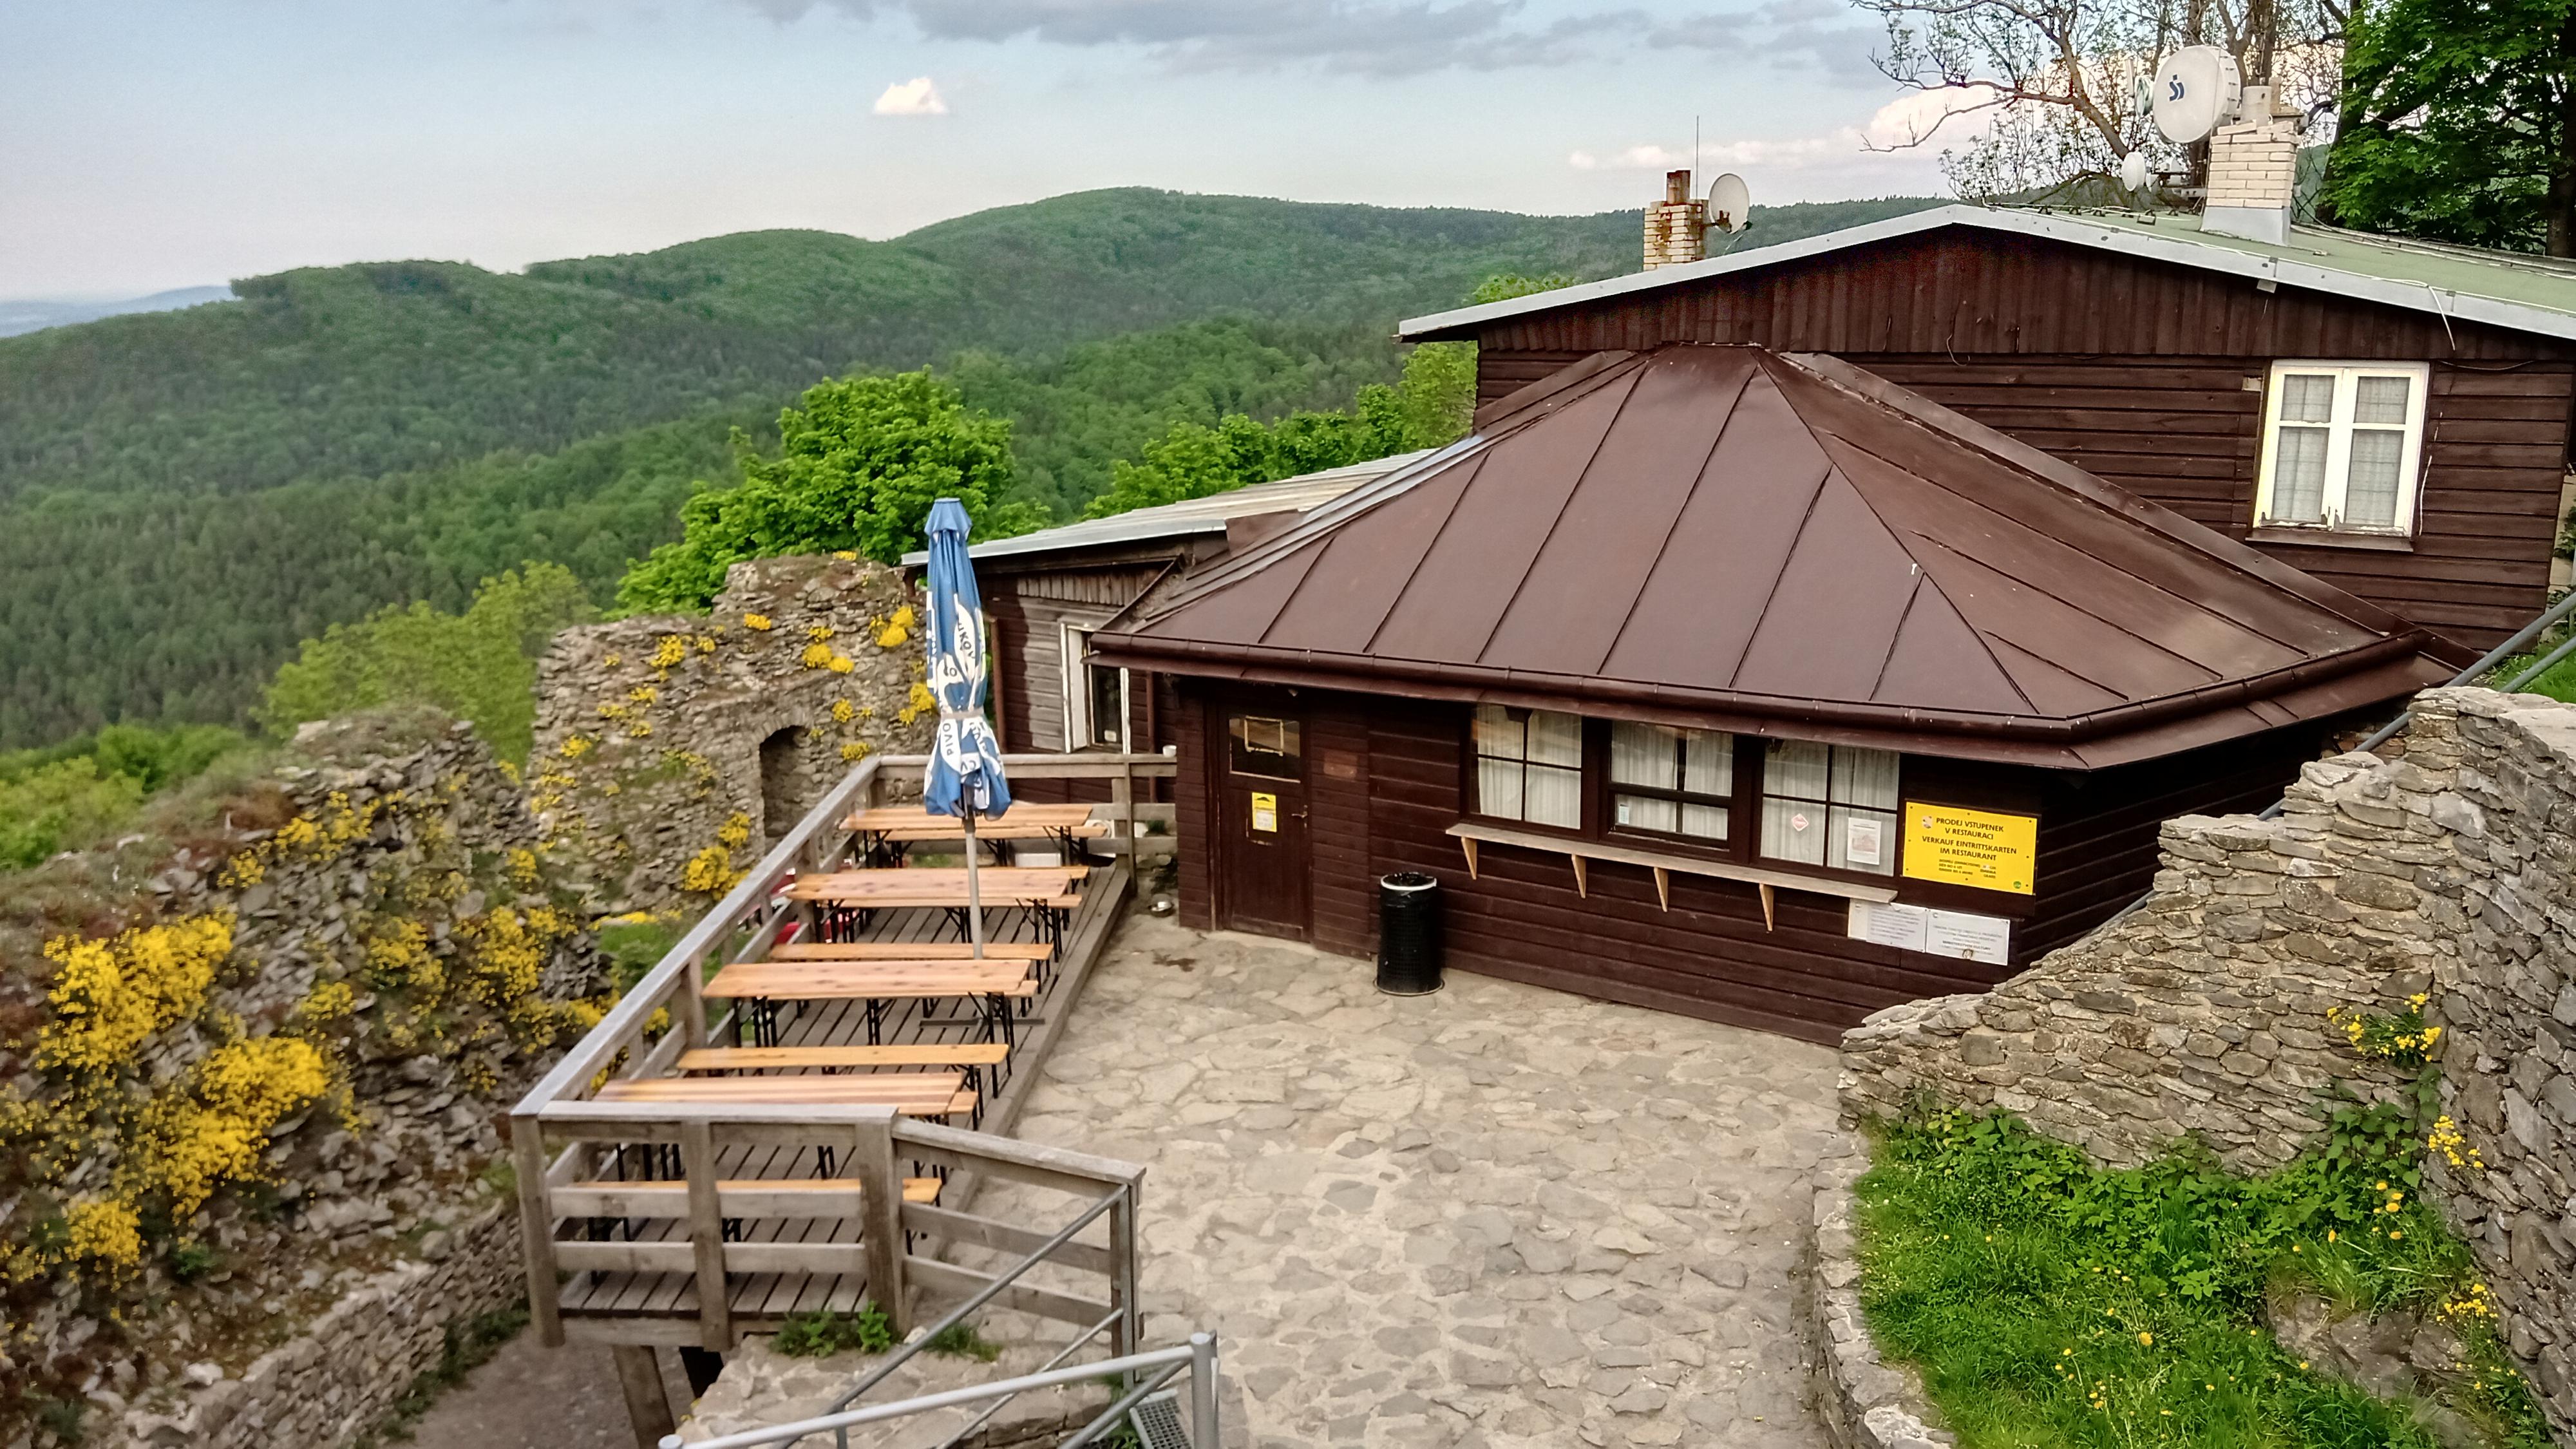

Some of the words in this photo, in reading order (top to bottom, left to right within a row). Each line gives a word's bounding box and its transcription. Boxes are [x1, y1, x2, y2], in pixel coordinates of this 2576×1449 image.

[942, 723, 954, 756] PIVO
[1936, 817, 1963, 826] PRODEJ
[1964, 820, 2004, 832] VSTUPENEK
[1952, 828, 1994, 840] RESTAURACI
[1922, 835, 1955, 846] VERKAUF
[1956, 840, 2017, 854] EINTRITTSKARTEN
[1952, 848, 1997, 861] RESTAURANT
